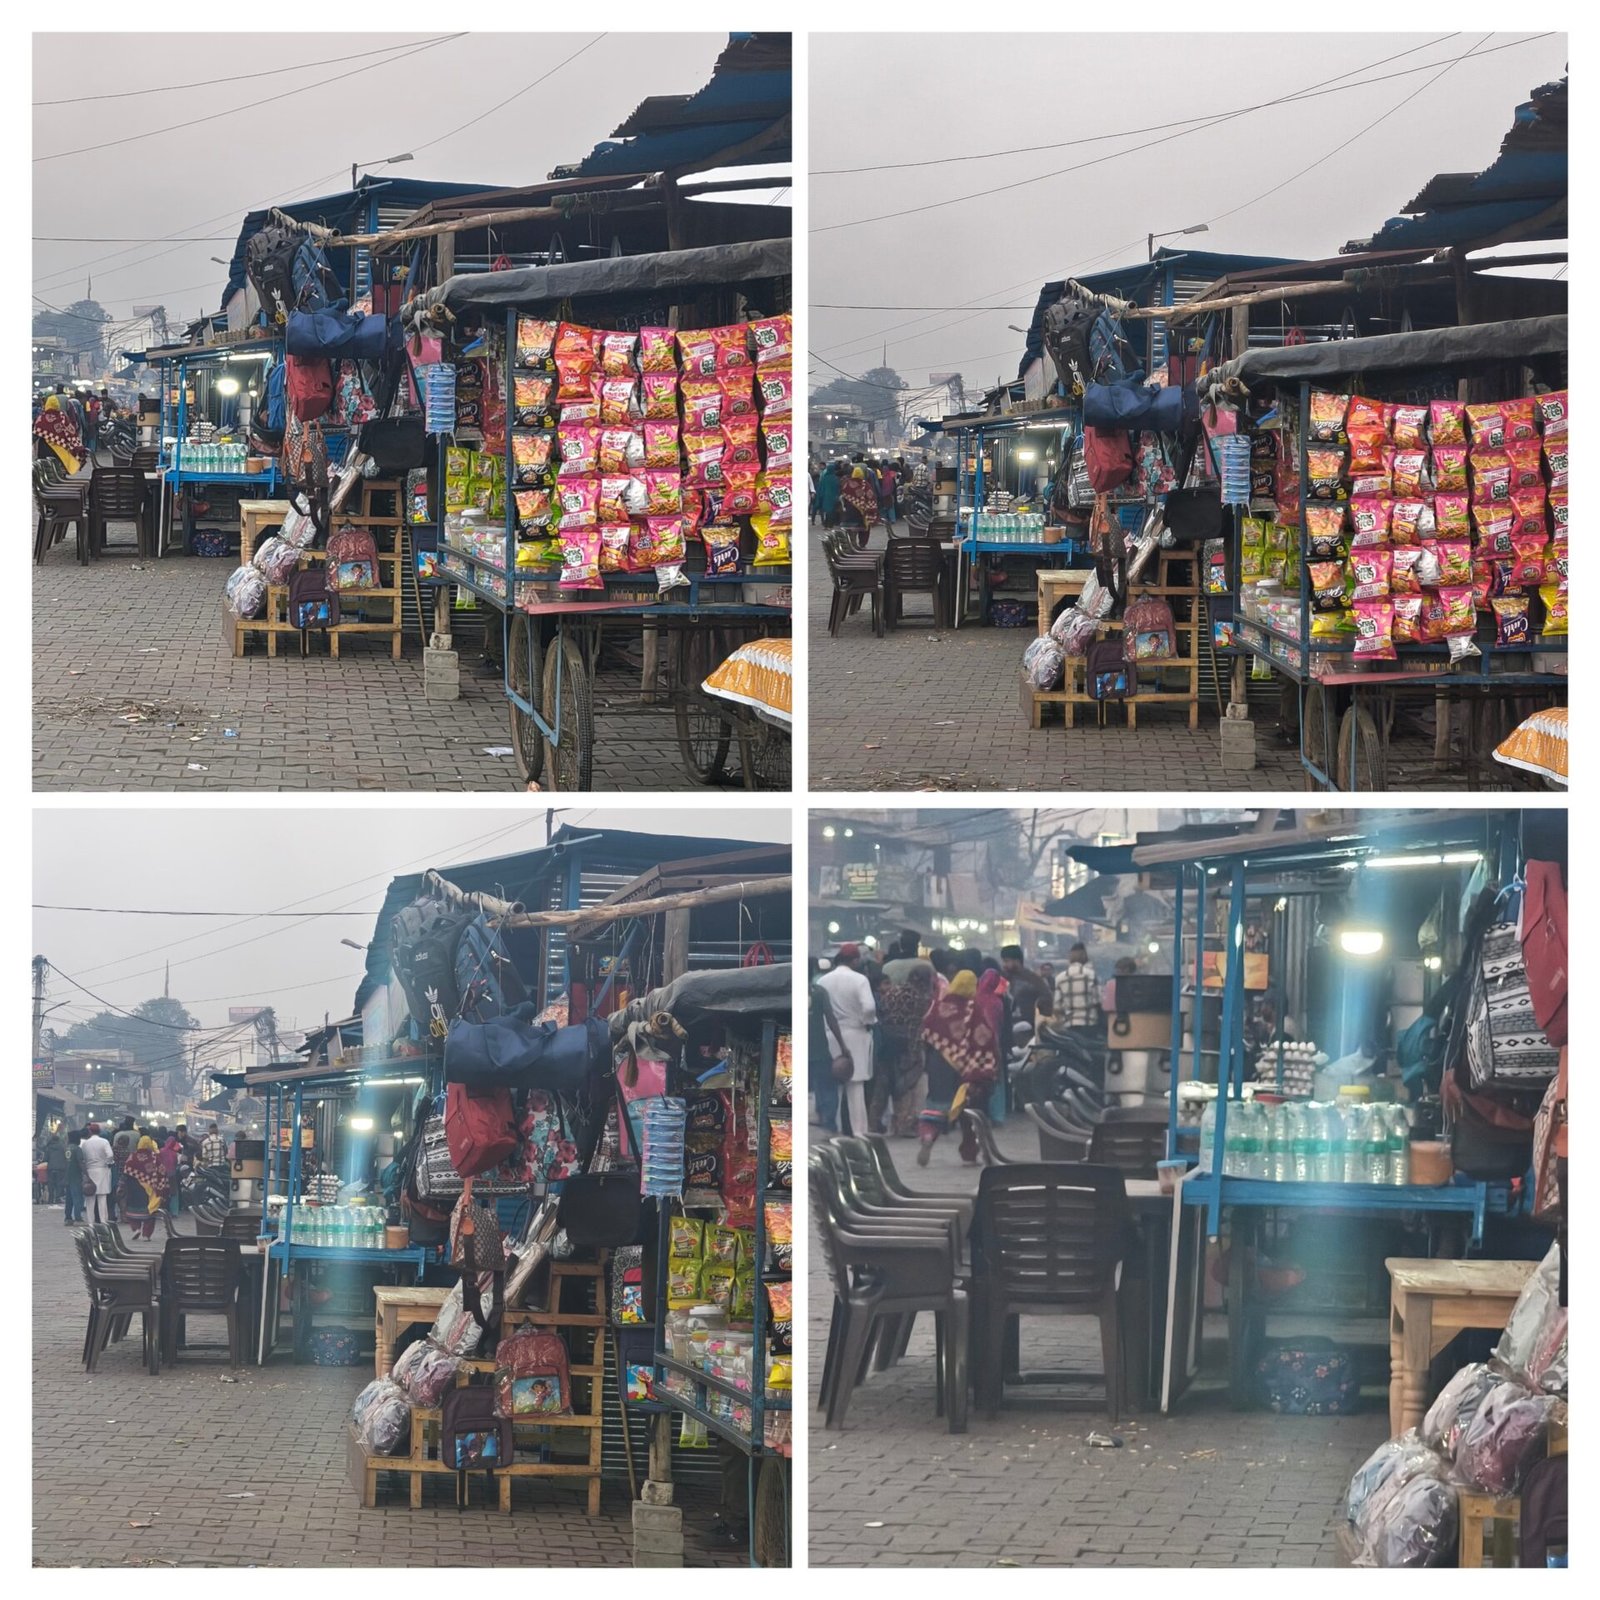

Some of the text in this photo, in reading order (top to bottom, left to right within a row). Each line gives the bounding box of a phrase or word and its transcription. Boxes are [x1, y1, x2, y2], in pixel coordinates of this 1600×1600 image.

[714, 546, 739, 567] Curls
[1503, 620, 1529, 639] Curls
[688, 1155, 717, 1175] Curls
